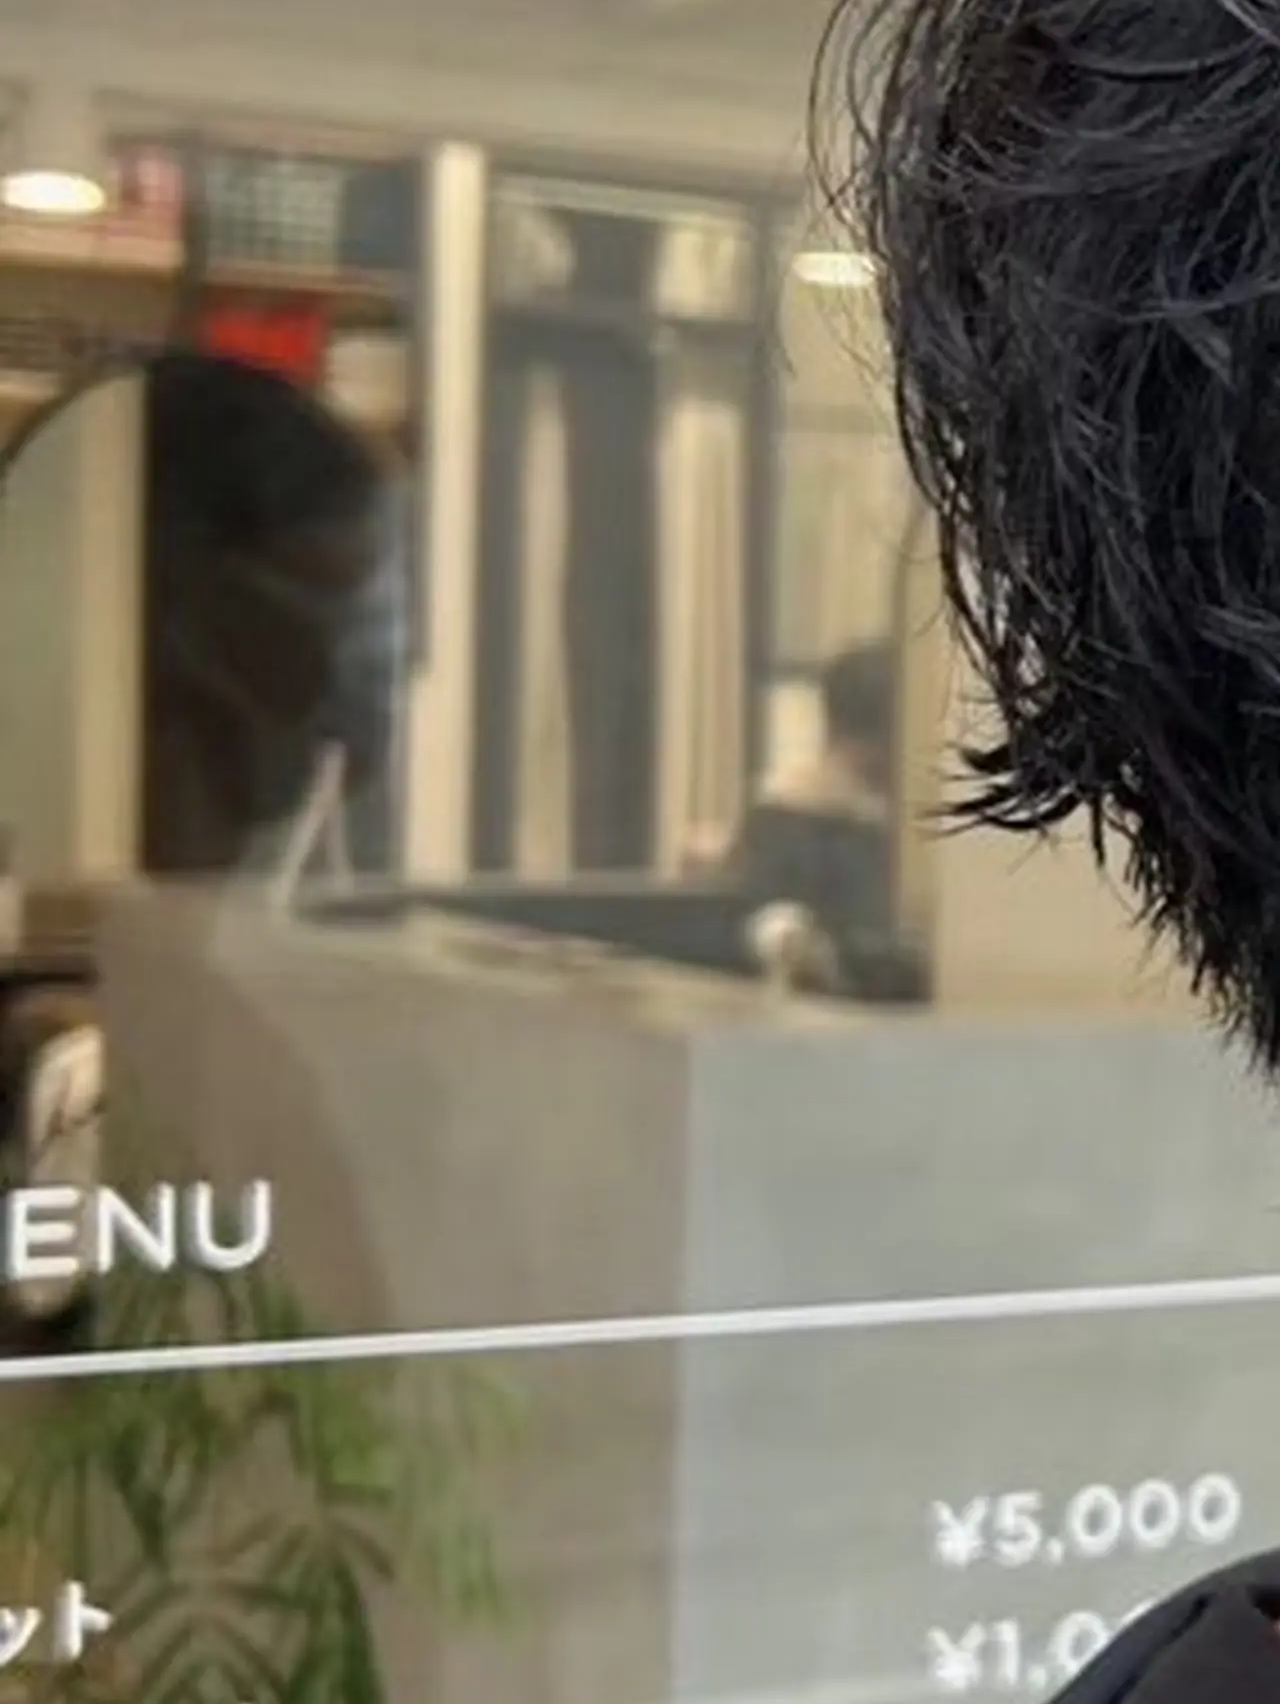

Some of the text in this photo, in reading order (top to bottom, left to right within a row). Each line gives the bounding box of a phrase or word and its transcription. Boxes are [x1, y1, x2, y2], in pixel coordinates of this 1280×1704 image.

[8, 1179, 272, 1280] ENU
[932, 1472, 1241, 1569] ¥5,000
[926, 1597, 1160, 1693] ¥1,0
